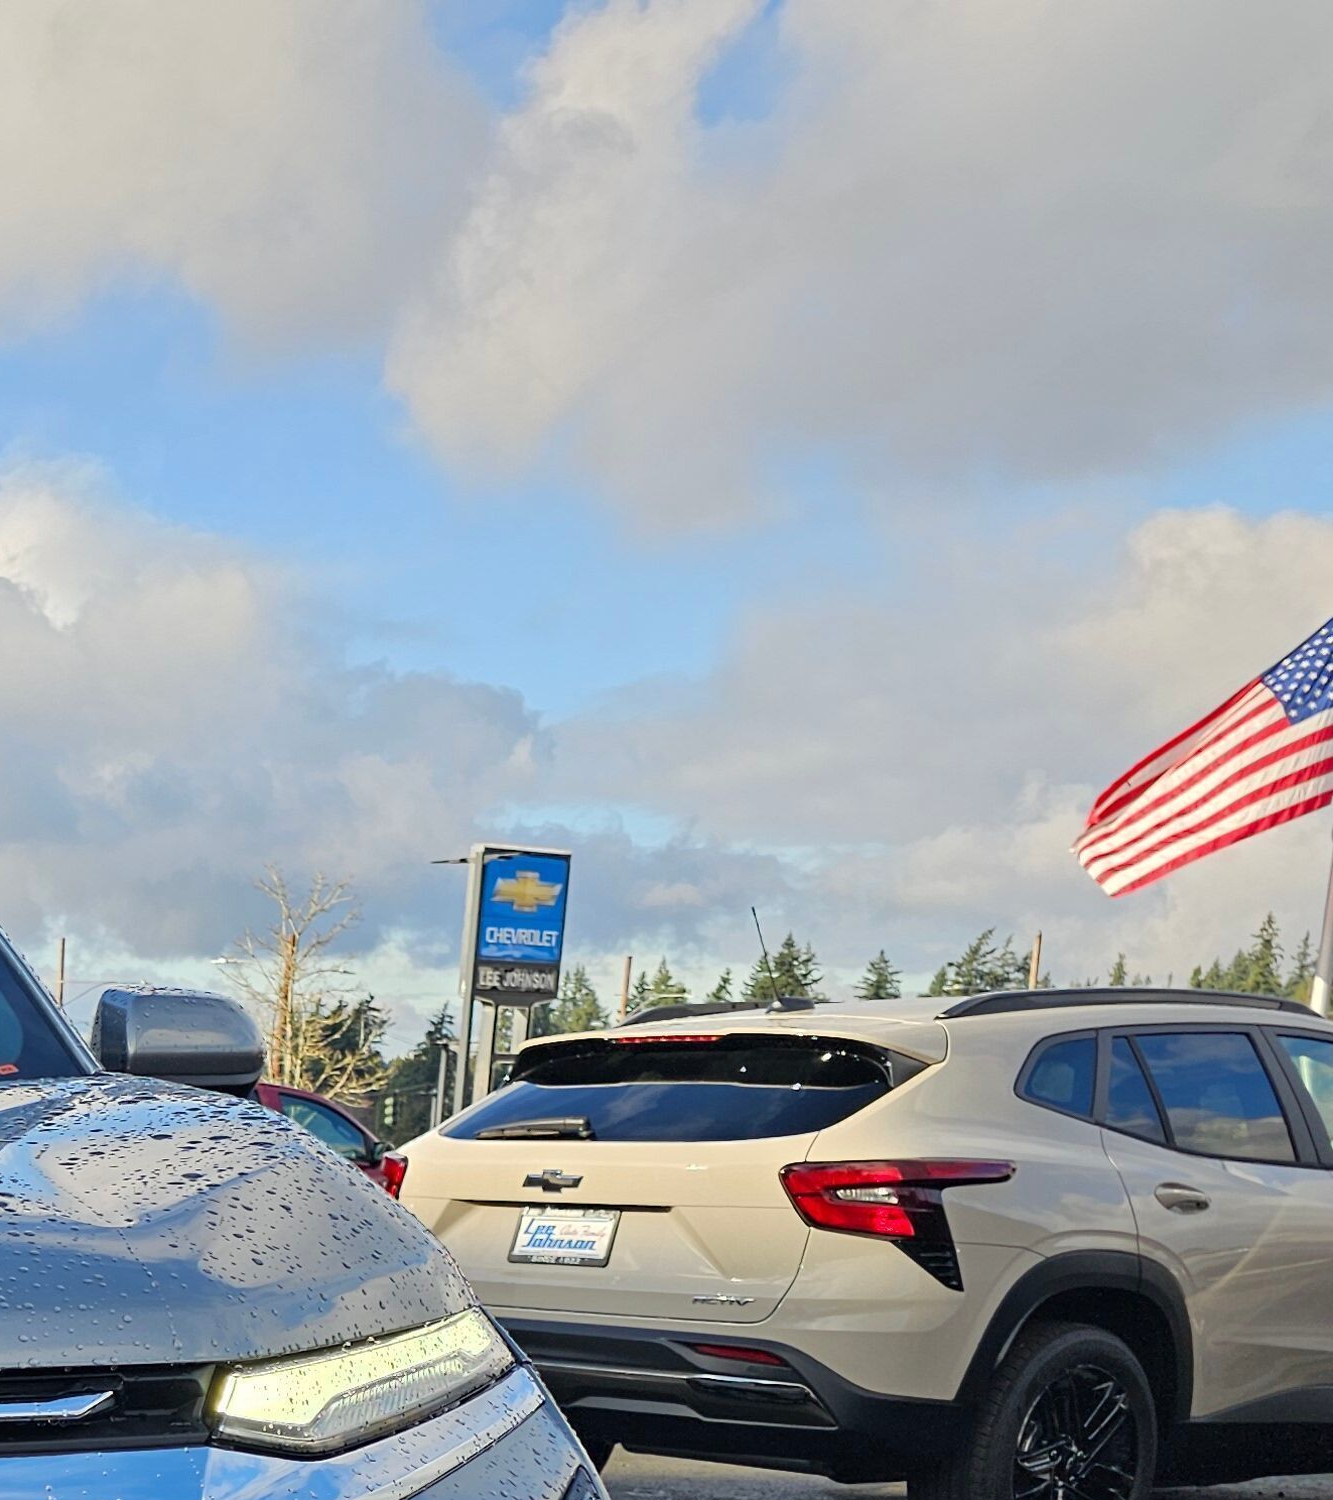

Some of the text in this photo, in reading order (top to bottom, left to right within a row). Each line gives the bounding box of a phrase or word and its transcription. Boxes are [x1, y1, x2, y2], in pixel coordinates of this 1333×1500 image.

[485, 926, 559, 947] CHEVROLET
[479, 968, 555, 992] LEE JOHNSON
[523, 1218, 556, 1235] Lee
[521, 1235, 597, 1251] Johnson
